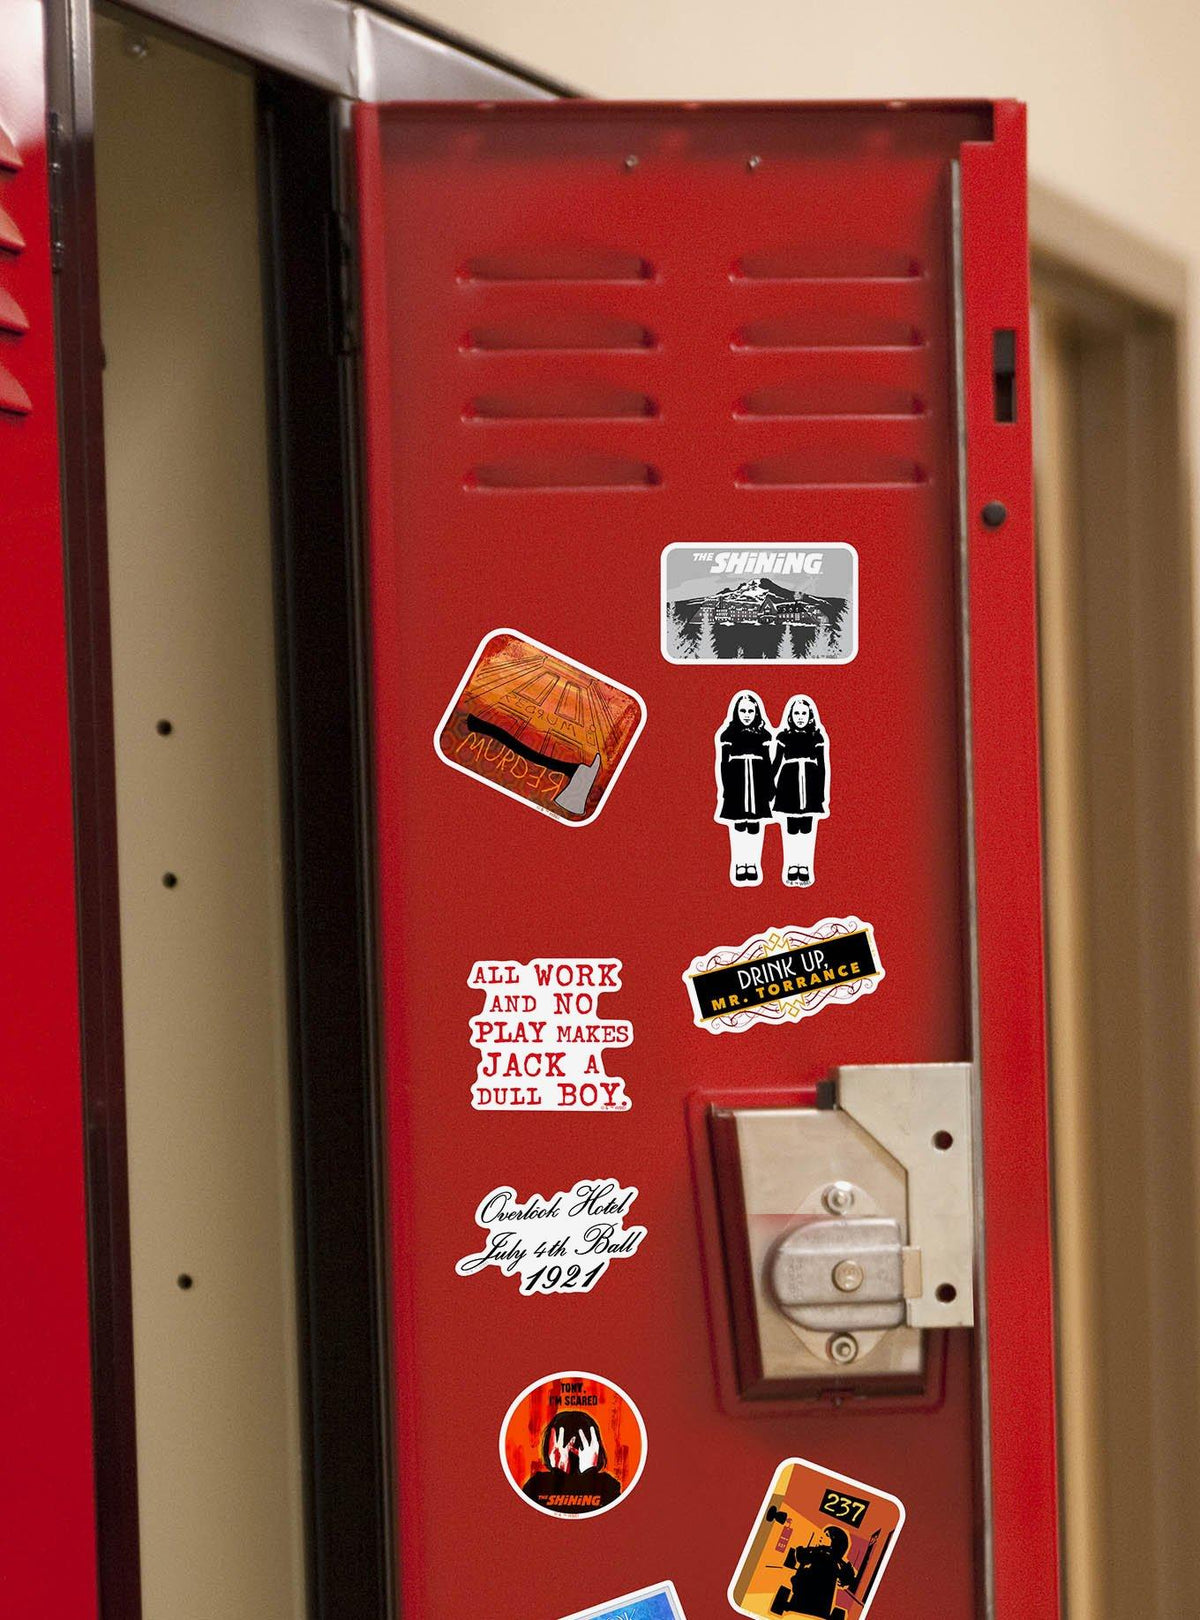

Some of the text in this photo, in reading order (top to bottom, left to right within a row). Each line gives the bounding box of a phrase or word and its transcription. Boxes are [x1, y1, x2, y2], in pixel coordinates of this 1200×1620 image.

[692, 552, 715, 562] THE
[473, 964, 617, 987] ALL WORK
[737, 949, 829, 990] DRINK UP,
[711, 961, 862, 1012] MR. TORRANCE
[490, 993, 593, 1015] AND NO
[475, 1021, 629, 1044] PLAY MAKES
[482, 1052, 600, 1077] JACK A
[477, 1083, 628, 1107] DULL BOY.
[480, 1183, 634, 1224] Overlook Hotel
[460, 1222, 642, 1272] July 4th Ball
[525, 1261, 605, 1291] 1921
[564, 1395, 598, 1406] SCARED
[823, 1493, 866, 1522] 237
